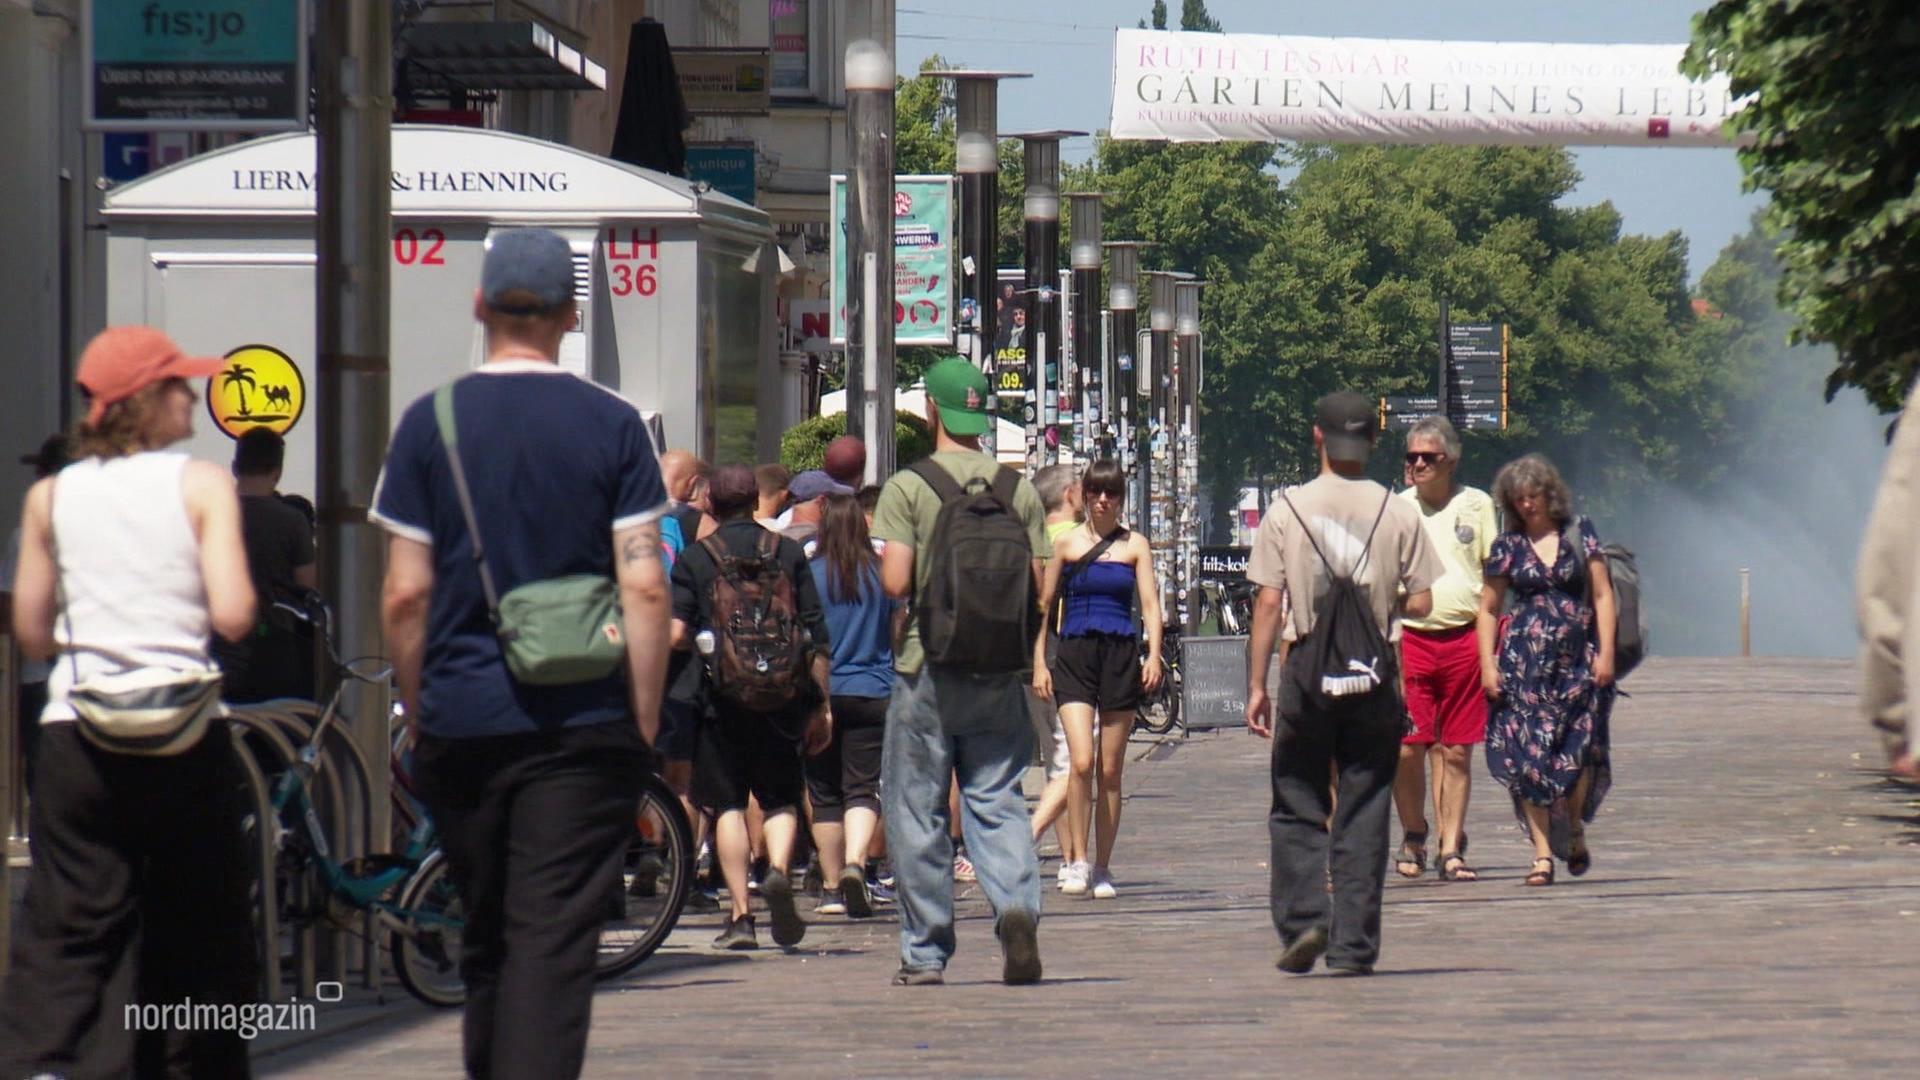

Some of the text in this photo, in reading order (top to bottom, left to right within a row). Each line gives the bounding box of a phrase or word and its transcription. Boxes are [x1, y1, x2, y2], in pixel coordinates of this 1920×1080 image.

[1137, 45, 1411, 76] RUTH TESMAR
[102, 67, 285, 84] ÜBER DER SPARDABANK
[1136, 70, 1345, 109] GÄRTEN
[1377, 81, 1584, 115] MEINES
[699, 157, 747, 173] unique
[233, 170, 317, 191] LIERM
[419, 171, 568, 193] HAENNING
[393, 228, 446, 265] 02
[608, 228, 658, 259] LH
[894, 234, 935, 246] HWERIN.
[612, 264, 658, 297] 36
[997, 348, 1026, 361] ASC
